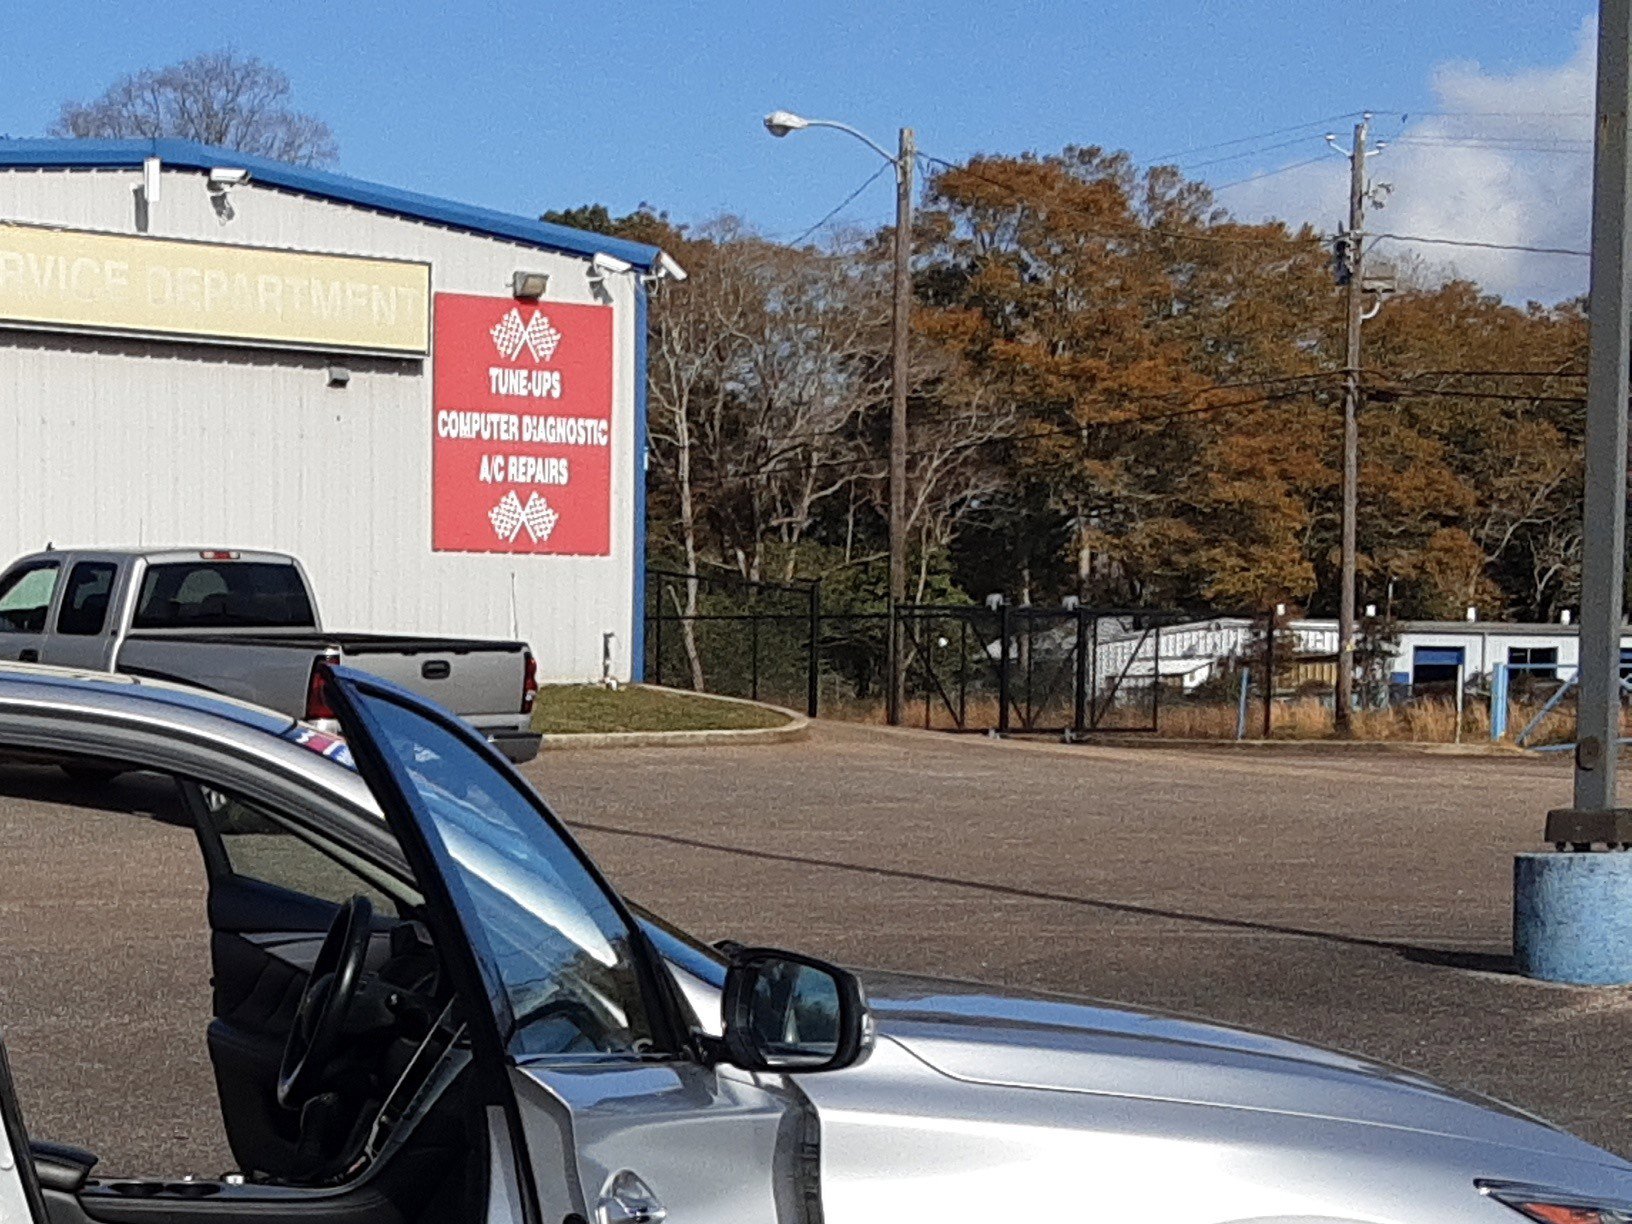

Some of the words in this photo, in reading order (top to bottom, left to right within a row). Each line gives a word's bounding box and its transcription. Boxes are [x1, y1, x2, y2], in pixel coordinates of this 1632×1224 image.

[146, 266, 420, 326] DEPARTMENT
[489, 367, 561, 398] TUNE-UPS
[437, 410, 518, 441] COMPUTER
[522, 415, 608, 446] DIAGNOSTIC
[479, 455, 505, 483] A/C
[508, 456, 568, 484] REPAIRS
